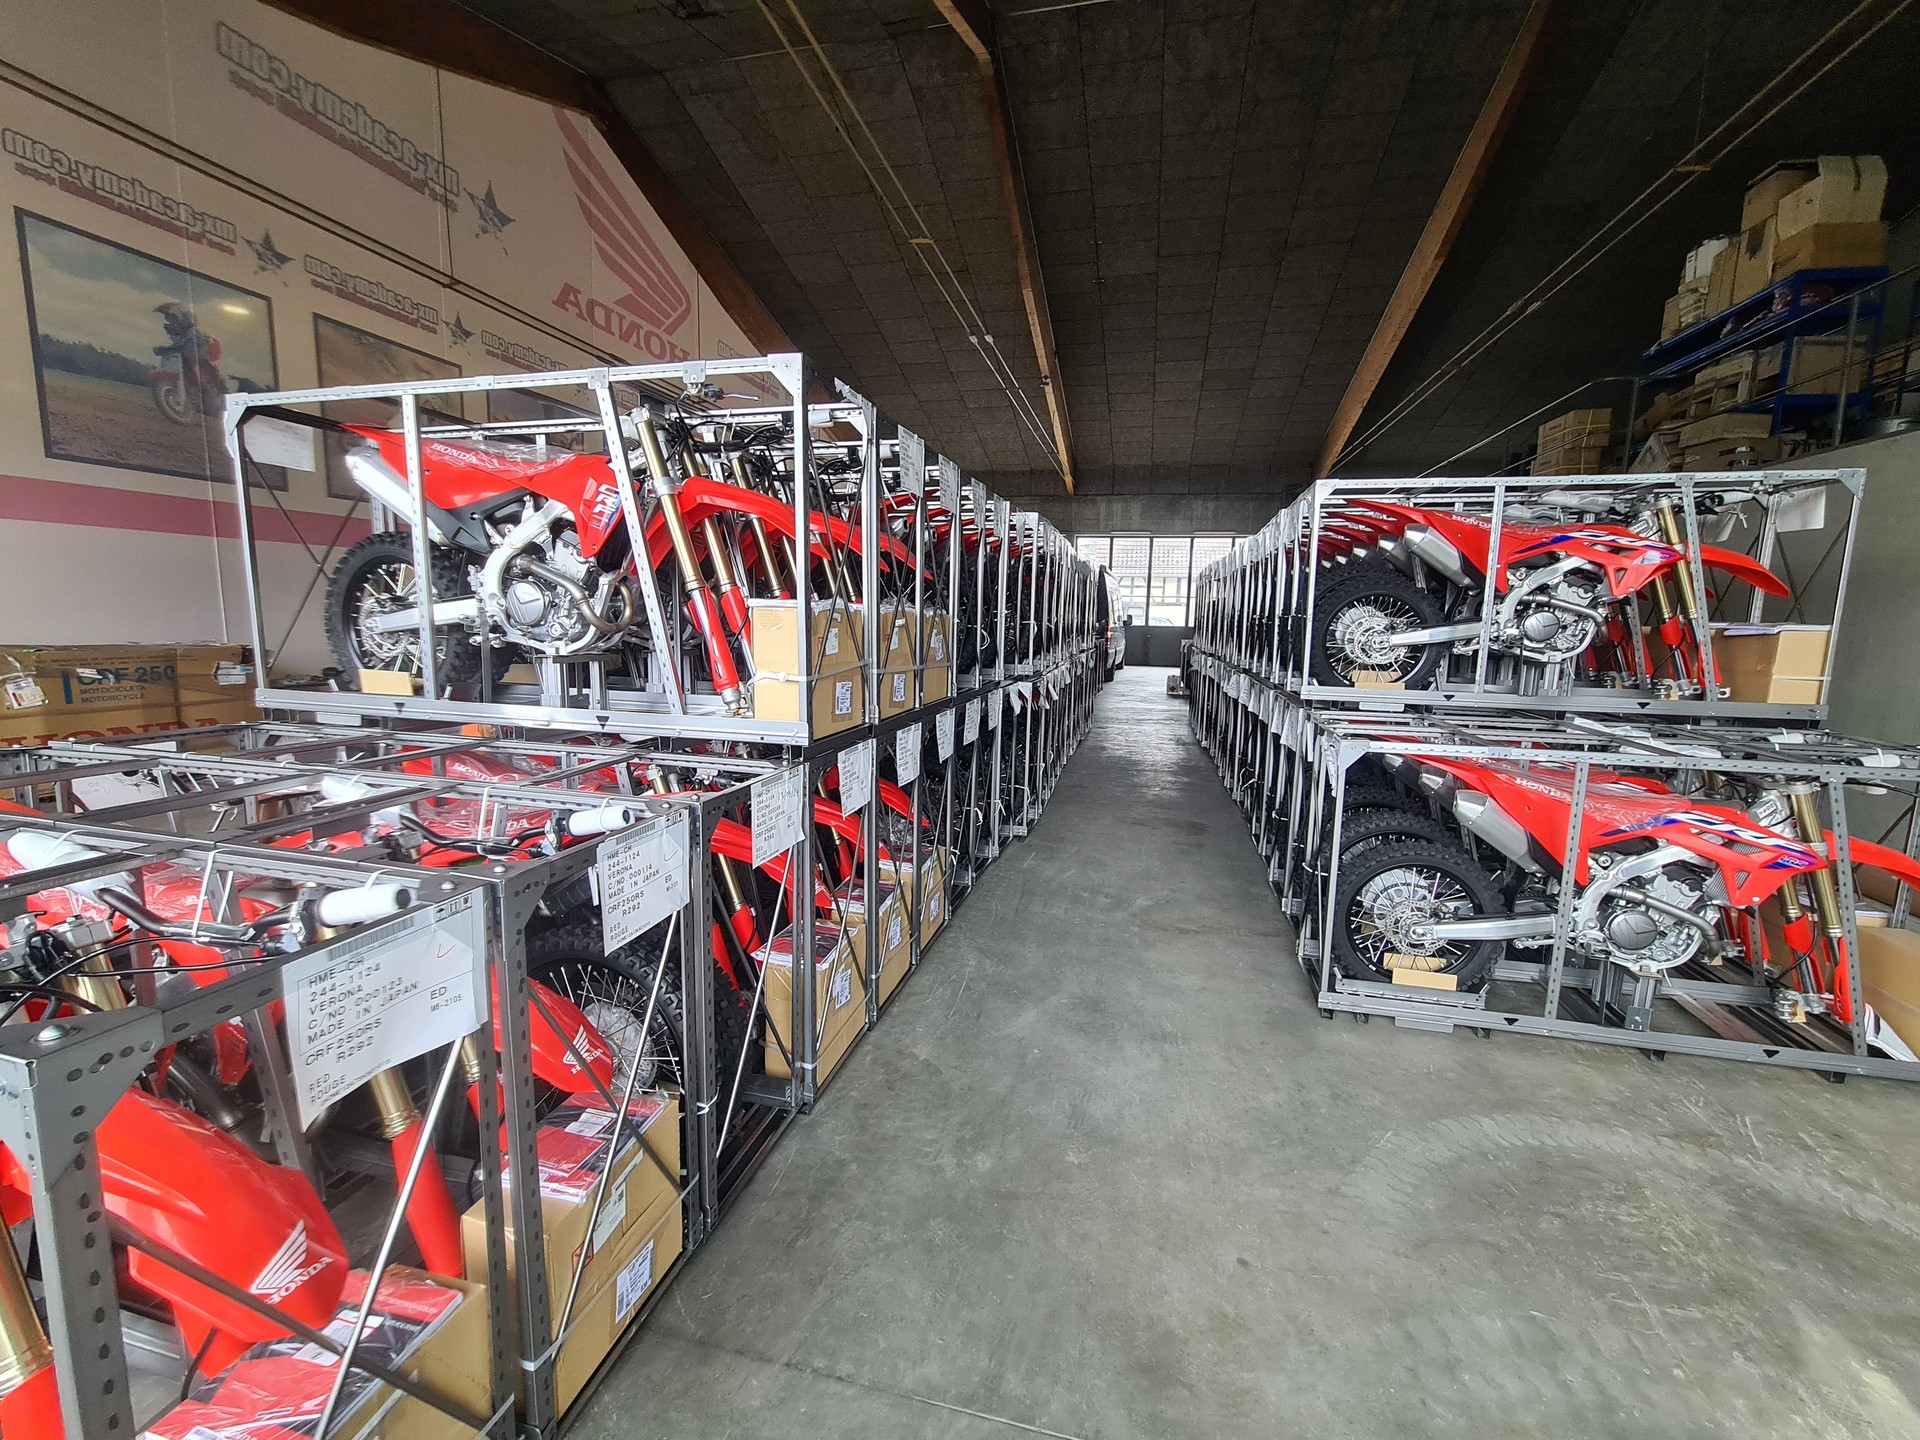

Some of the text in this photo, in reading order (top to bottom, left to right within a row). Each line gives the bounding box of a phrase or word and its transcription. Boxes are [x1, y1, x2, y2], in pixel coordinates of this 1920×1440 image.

[431, 443, 477, 463] HONDA
[134, 665, 176, 683] 250
[80, 685, 147, 695] MOTOCICLETA
[80, 693, 145, 704] MOTORCYCLE
[607, 845, 632, 861] HME-CH
[607, 851, 640, 871] 244-1124
[607, 864, 633, 881] VERONA
[664, 874, 673, 884] ED
[608, 867, 660, 900] MADE IN JAPAN
[607, 890, 645, 914] CRF250RS
[622, 902, 641, 917] R292
[609, 922, 621, 933] RED
[308, 956, 365, 989] HME-CH
[309, 962, 382, 1002] 244-1124
[308, 984, 364, 1016] VERONA
[430, 986, 448, 1001] ED
[430, 993, 463, 1013] M6-2105
[307, 980, 418, 1045] MADE IN JAPAN
[305, 1017, 383, 1067] CRF250RS
[335, 1036, 375, 1065] R292
[570, 1047, 604, 1076] HNDA
[308, 1073, 331, 1094] RED
[310, 1074, 347, 1106] ROUGE
[264, 1256, 334, 1304] HONDA
